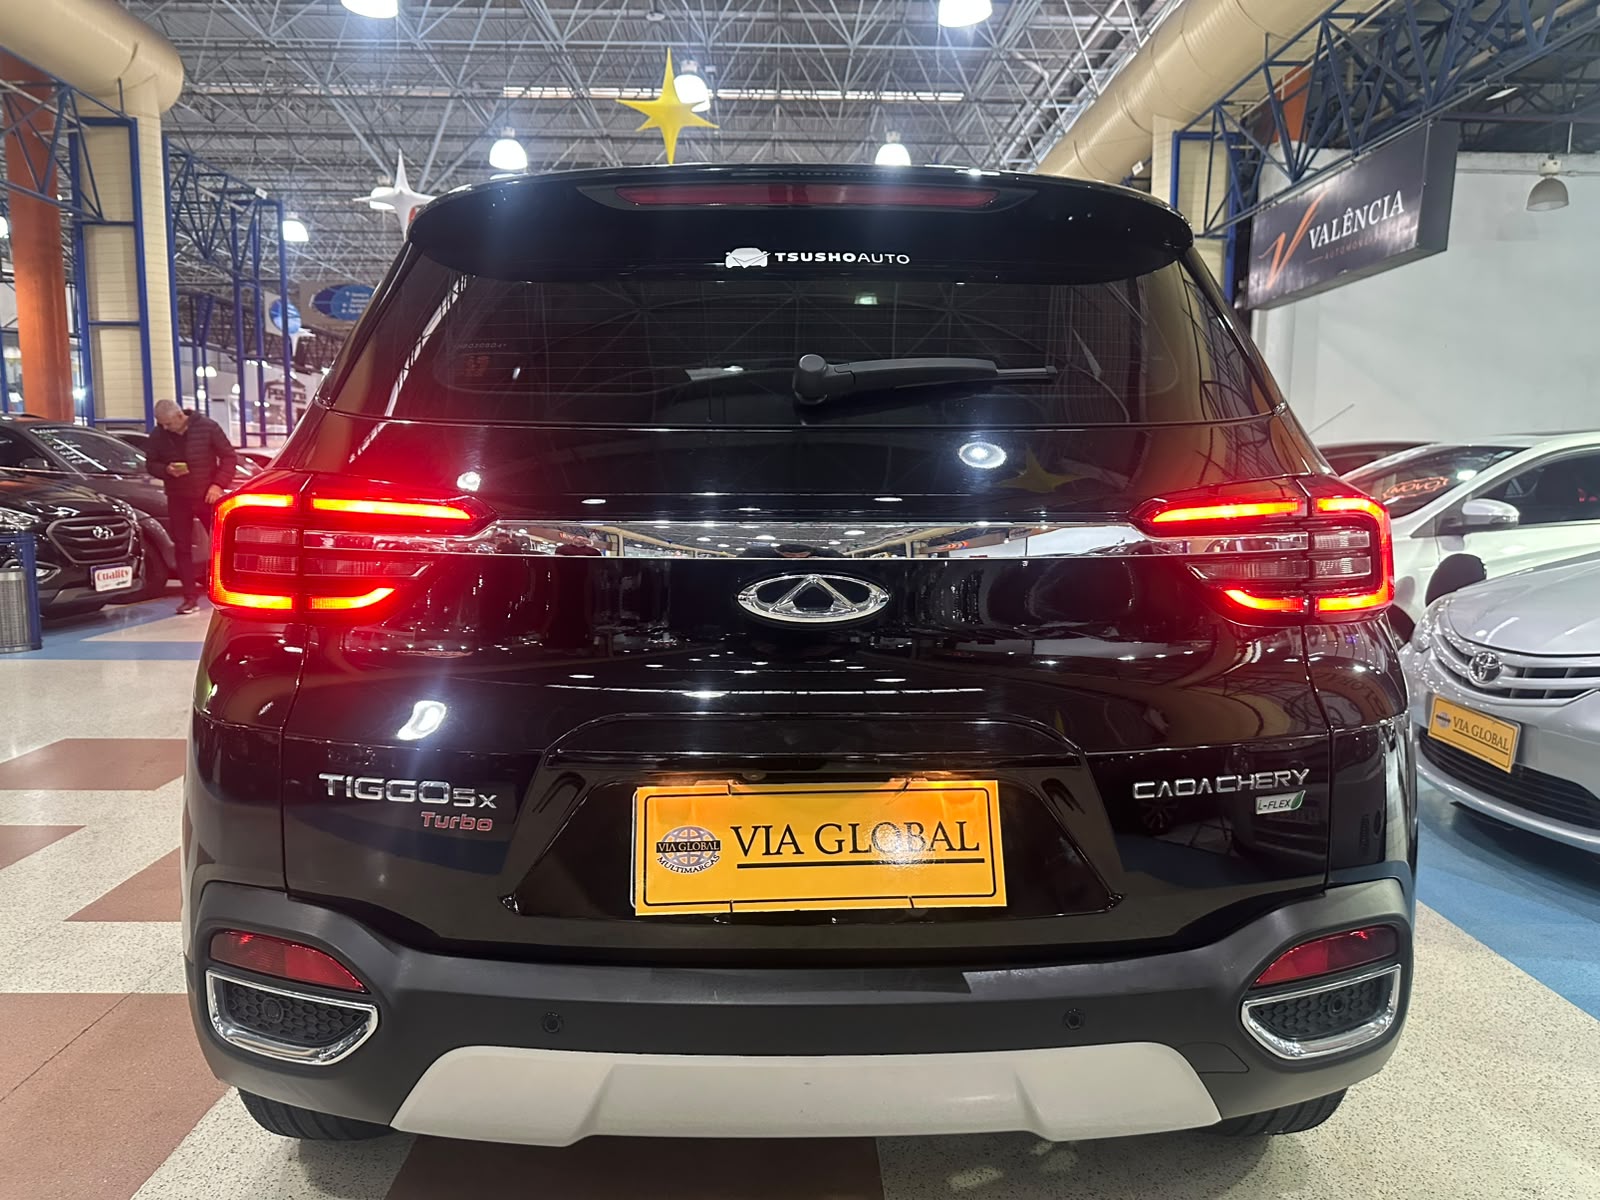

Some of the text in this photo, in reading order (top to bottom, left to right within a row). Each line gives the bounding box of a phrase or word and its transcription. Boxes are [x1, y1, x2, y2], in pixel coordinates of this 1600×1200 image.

[1308, 190, 1404, 250] VALÊNCIA
[1453, 716, 1509, 752] VIA GLOBAL
[1258, 800, 1291, 811] L-FLEX
[421, 811, 493, 831] Turbo
[658, 841, 719, 852] VIA GLOBAL
[730, 821, 980, 857] VIA GLOBAL
[657, 854, 720, 874] MULTIMARCAS
